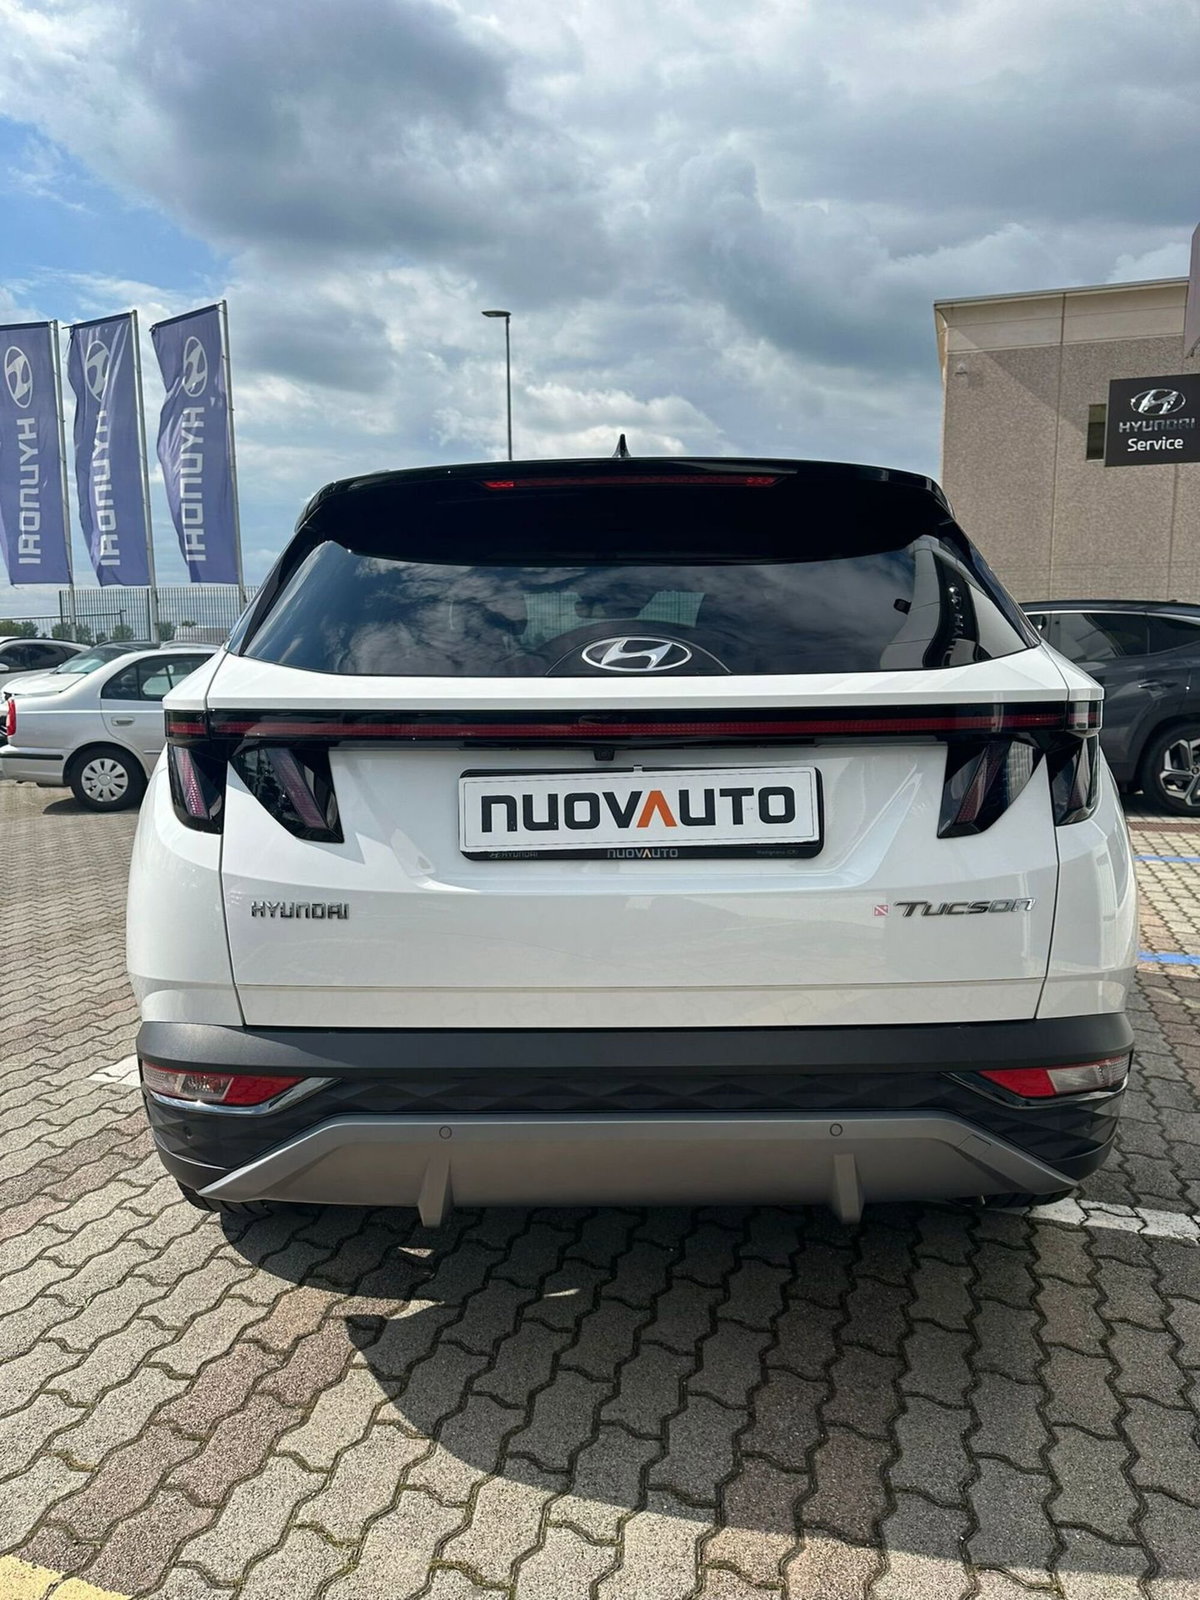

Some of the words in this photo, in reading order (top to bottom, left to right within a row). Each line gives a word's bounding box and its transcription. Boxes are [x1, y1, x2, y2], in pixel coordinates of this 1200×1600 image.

[1118, 417, 1196, 433] HYUNDAI
[1127, 436, 1184, 452] Service
[481, 786, 796, 833] NUOVAUTO
[251, 900, 350, 920] HYUNDAI
